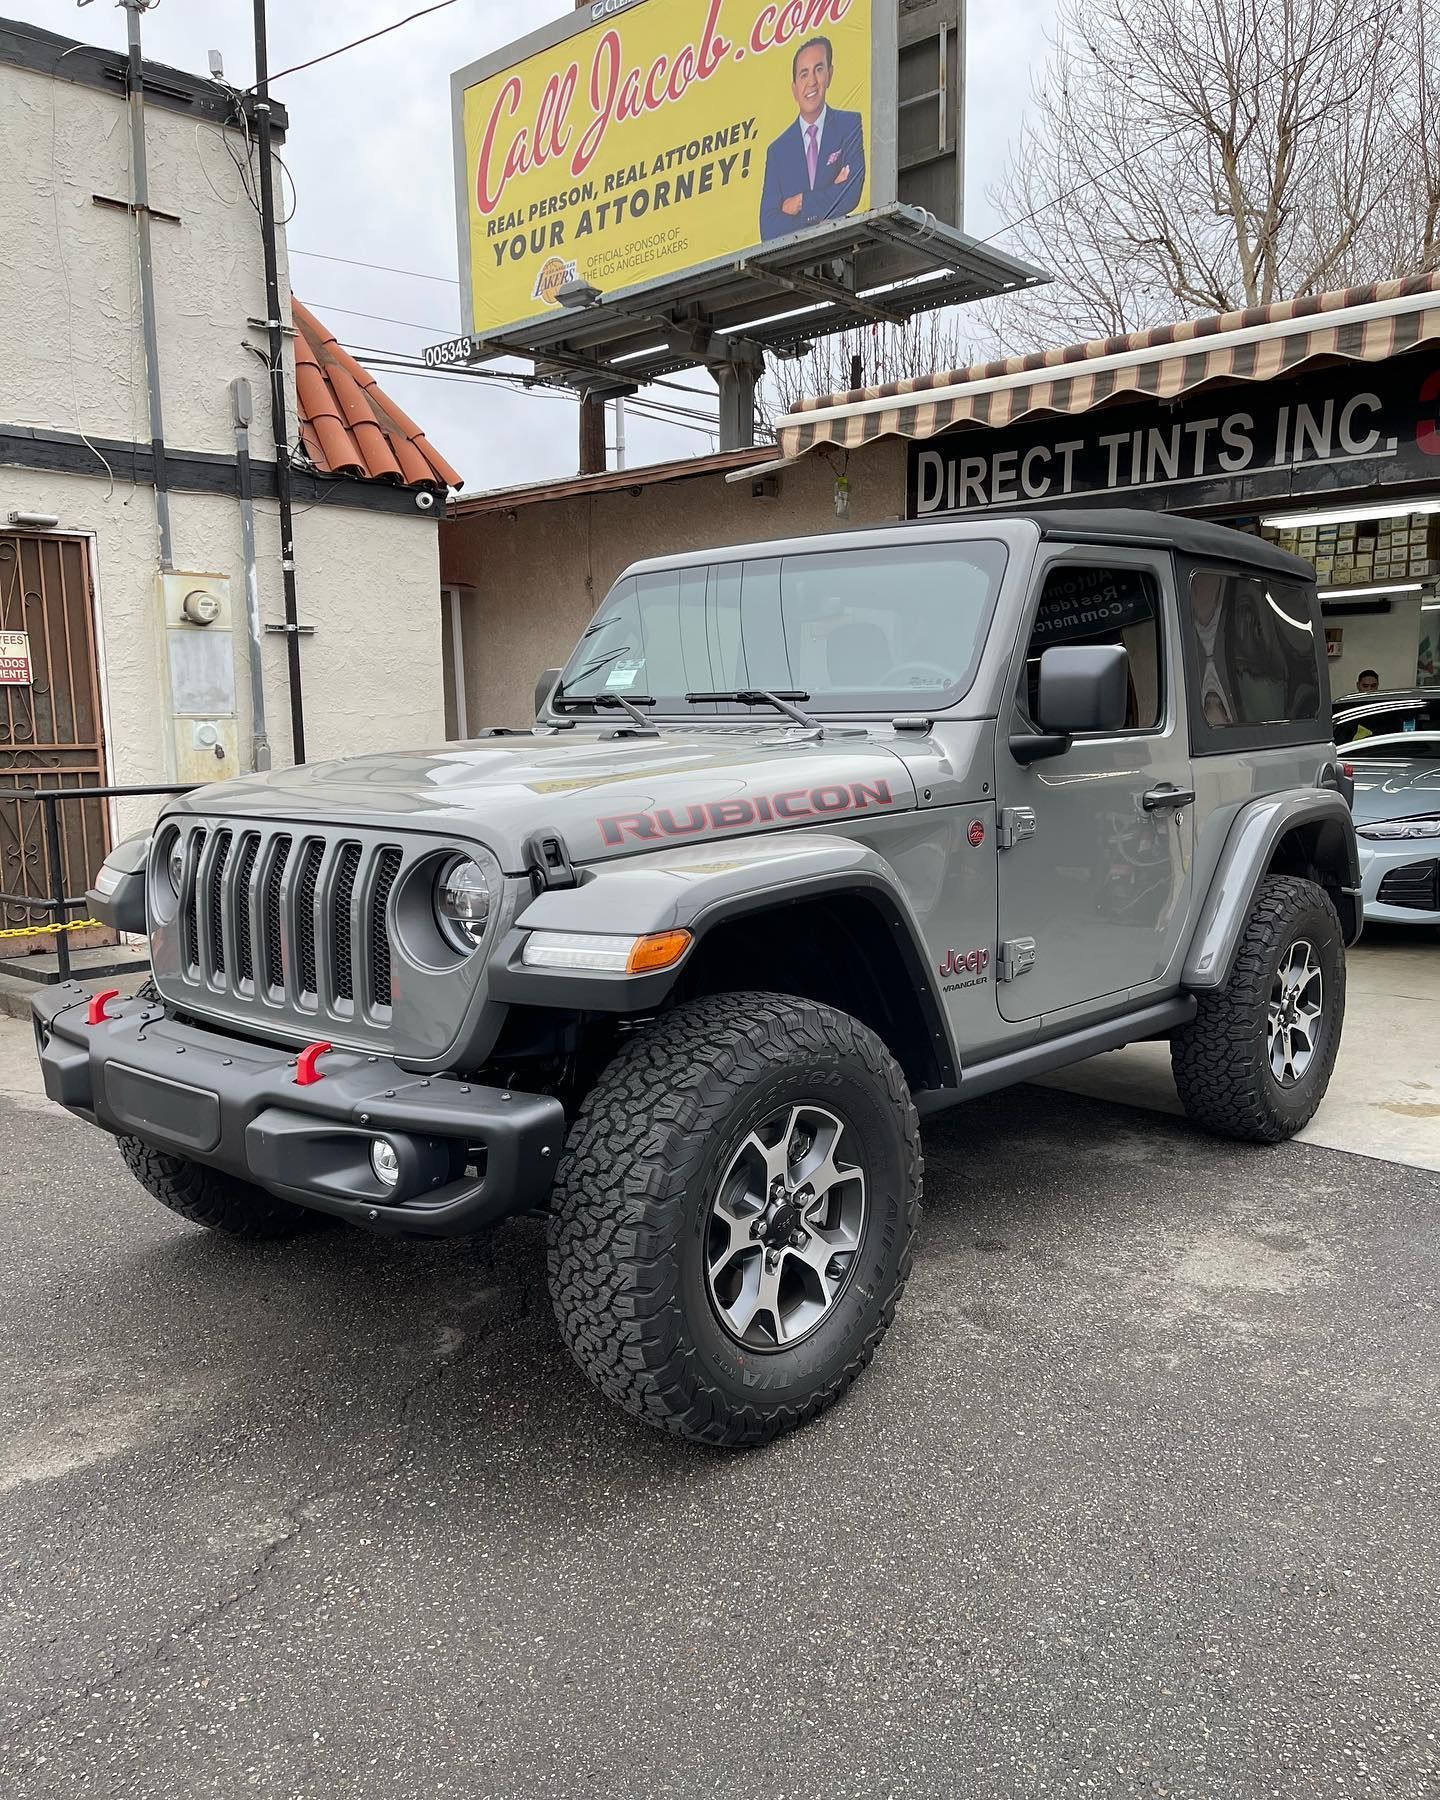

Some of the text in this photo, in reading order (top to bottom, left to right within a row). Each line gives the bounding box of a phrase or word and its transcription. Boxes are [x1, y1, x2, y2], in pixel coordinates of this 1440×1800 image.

[476, 0, 851, 214] Call Jacob.com
[487, 117, 758, 237] REAL PERSON, REAL ATTORNEY,
[494, 148, 751, 266] YOUR ATTORNEY!
[583, 238, 689, 281] THE LOS ANGELES LAKERS
[587, 227, 681, 267] OFFICIAL SPONSOR OF
[536, 268, 576, 296] LAKERS
[426, 338, 471, 367] 005343
[917, 392, 1398, 513] DIRECT TINTS INC.
[596, 779, 894, 847] RUBICON
[939, 948, 990, 977] Jeep
[942, 976, 988, 993] WRANGLER
